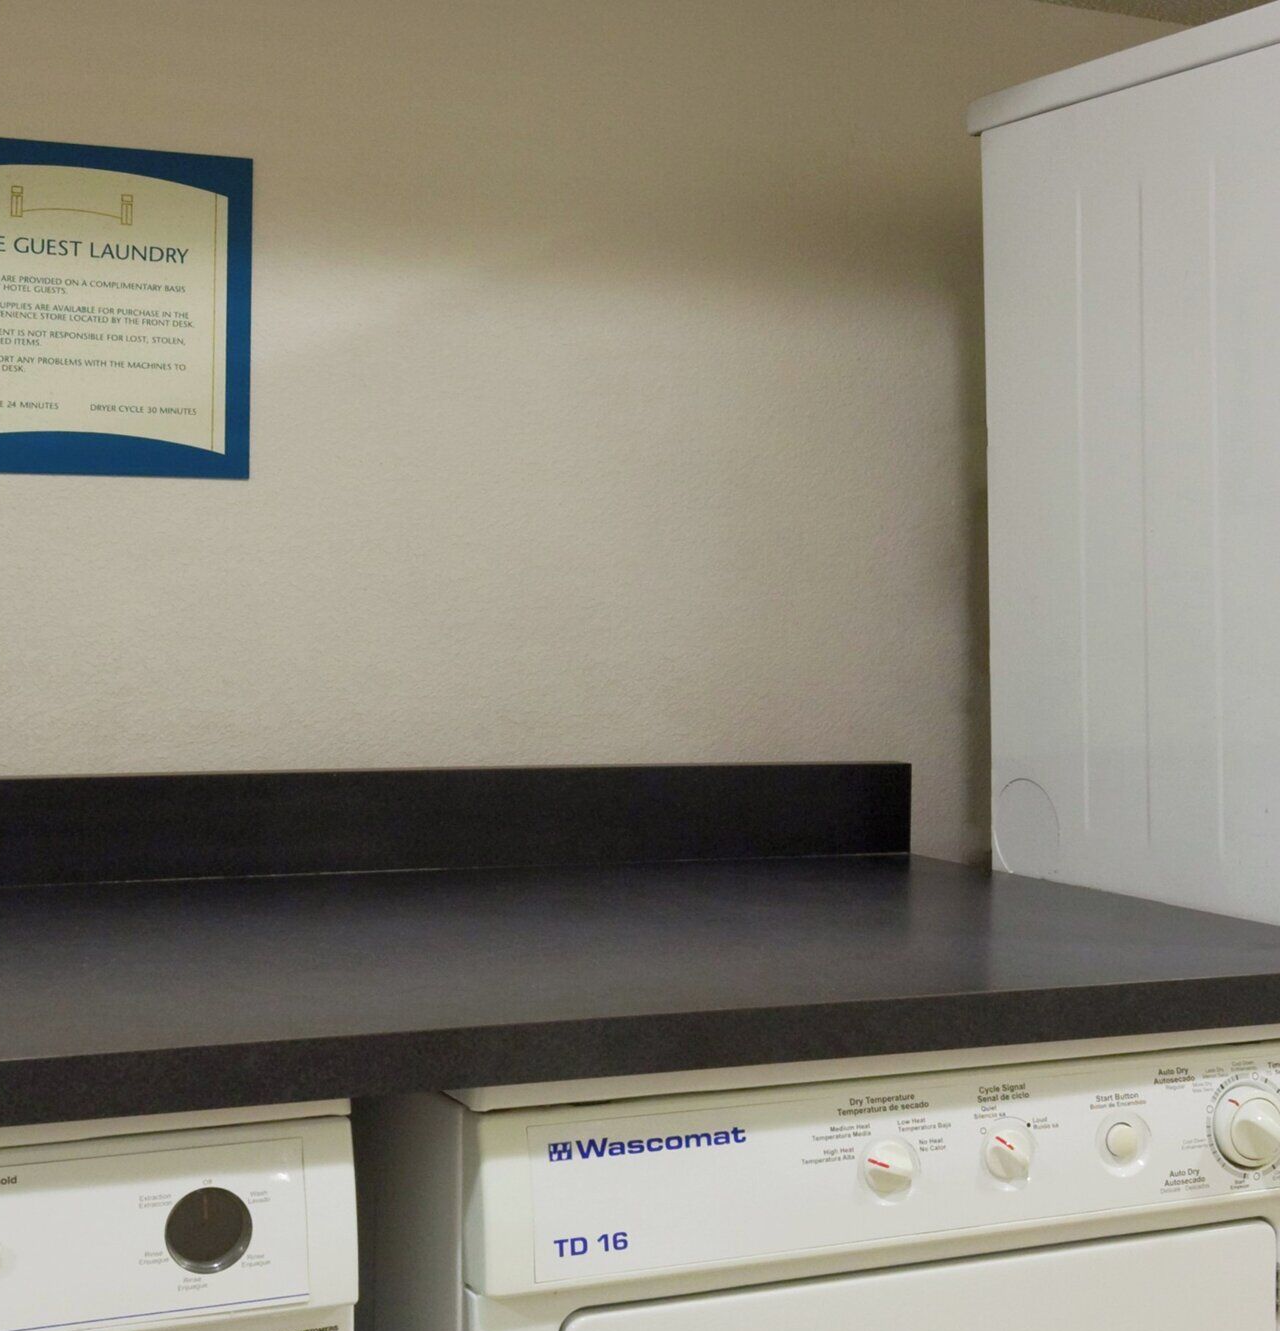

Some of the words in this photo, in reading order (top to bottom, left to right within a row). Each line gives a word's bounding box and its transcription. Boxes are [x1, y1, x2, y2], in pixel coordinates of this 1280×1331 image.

[13, 237, 82, 256] GUEST
[90, 242, 189, 264] LAUNDRY
[1, 274, 16, 283] ARE
[19, 276, 62, 286] PROVIDED
[90, 280, 161, 292] COMPLIMENTARY
[164, 285, 185, 293] BASIS
[4, 284, 31, 292] HOTEL
[53, 304, 95, 313] AVAILABLE
[117, 308, 160, 318] PURCHASE
[40, 312, 66, 321] STORE
[69, 315, 108, 323] LOCATED
[142, 318, 170, 326] FRONT
[27, 330, 47, 338] NOT
[50, 331, 104, 341] RESPONSIBLE
[38, 357, 82, 366] PROBLEMS
[110, 360, 125, 368] THE
[127, 362, 172, 371] MACHINES
[7, 400, 17, 408] 24
[20, 402, 59, 410] MINUTES
[90, 404, 116, 412] DRYER
[118, 405, 144, 414] CYCLE
[147, 406, 157, 414] 30
[160, 407, 197, 416] MINUTES
[1158, 1068, 1173, 1076] Auto
[1175, 1067, 1189, 1076] Dry
[1153, 1075, 1195, 1085] Autosecado
[979, 1085, 1000, 1095] Cycle
[1001, 1083, 1025, 1094] Signal
[1012, 1091, 1029, 1100] ciclo
[849, 1097, 866, 1108] Dry
[869, 1093, 914, 1106] Temperature
[1096, 1093, 1113, 1102] Start
[1115, 1092, 1139, 1101] Button
[837, 1105, 887, 1117] Temperatura
[889, 1103, 899, 1112] de
[901, 1101, 929, 1110] secado
[576, 1127, 746, 1159] Wascomat
[554, 1237, 588, 1257] TD
[597, 1232, 628, 1252] 16
